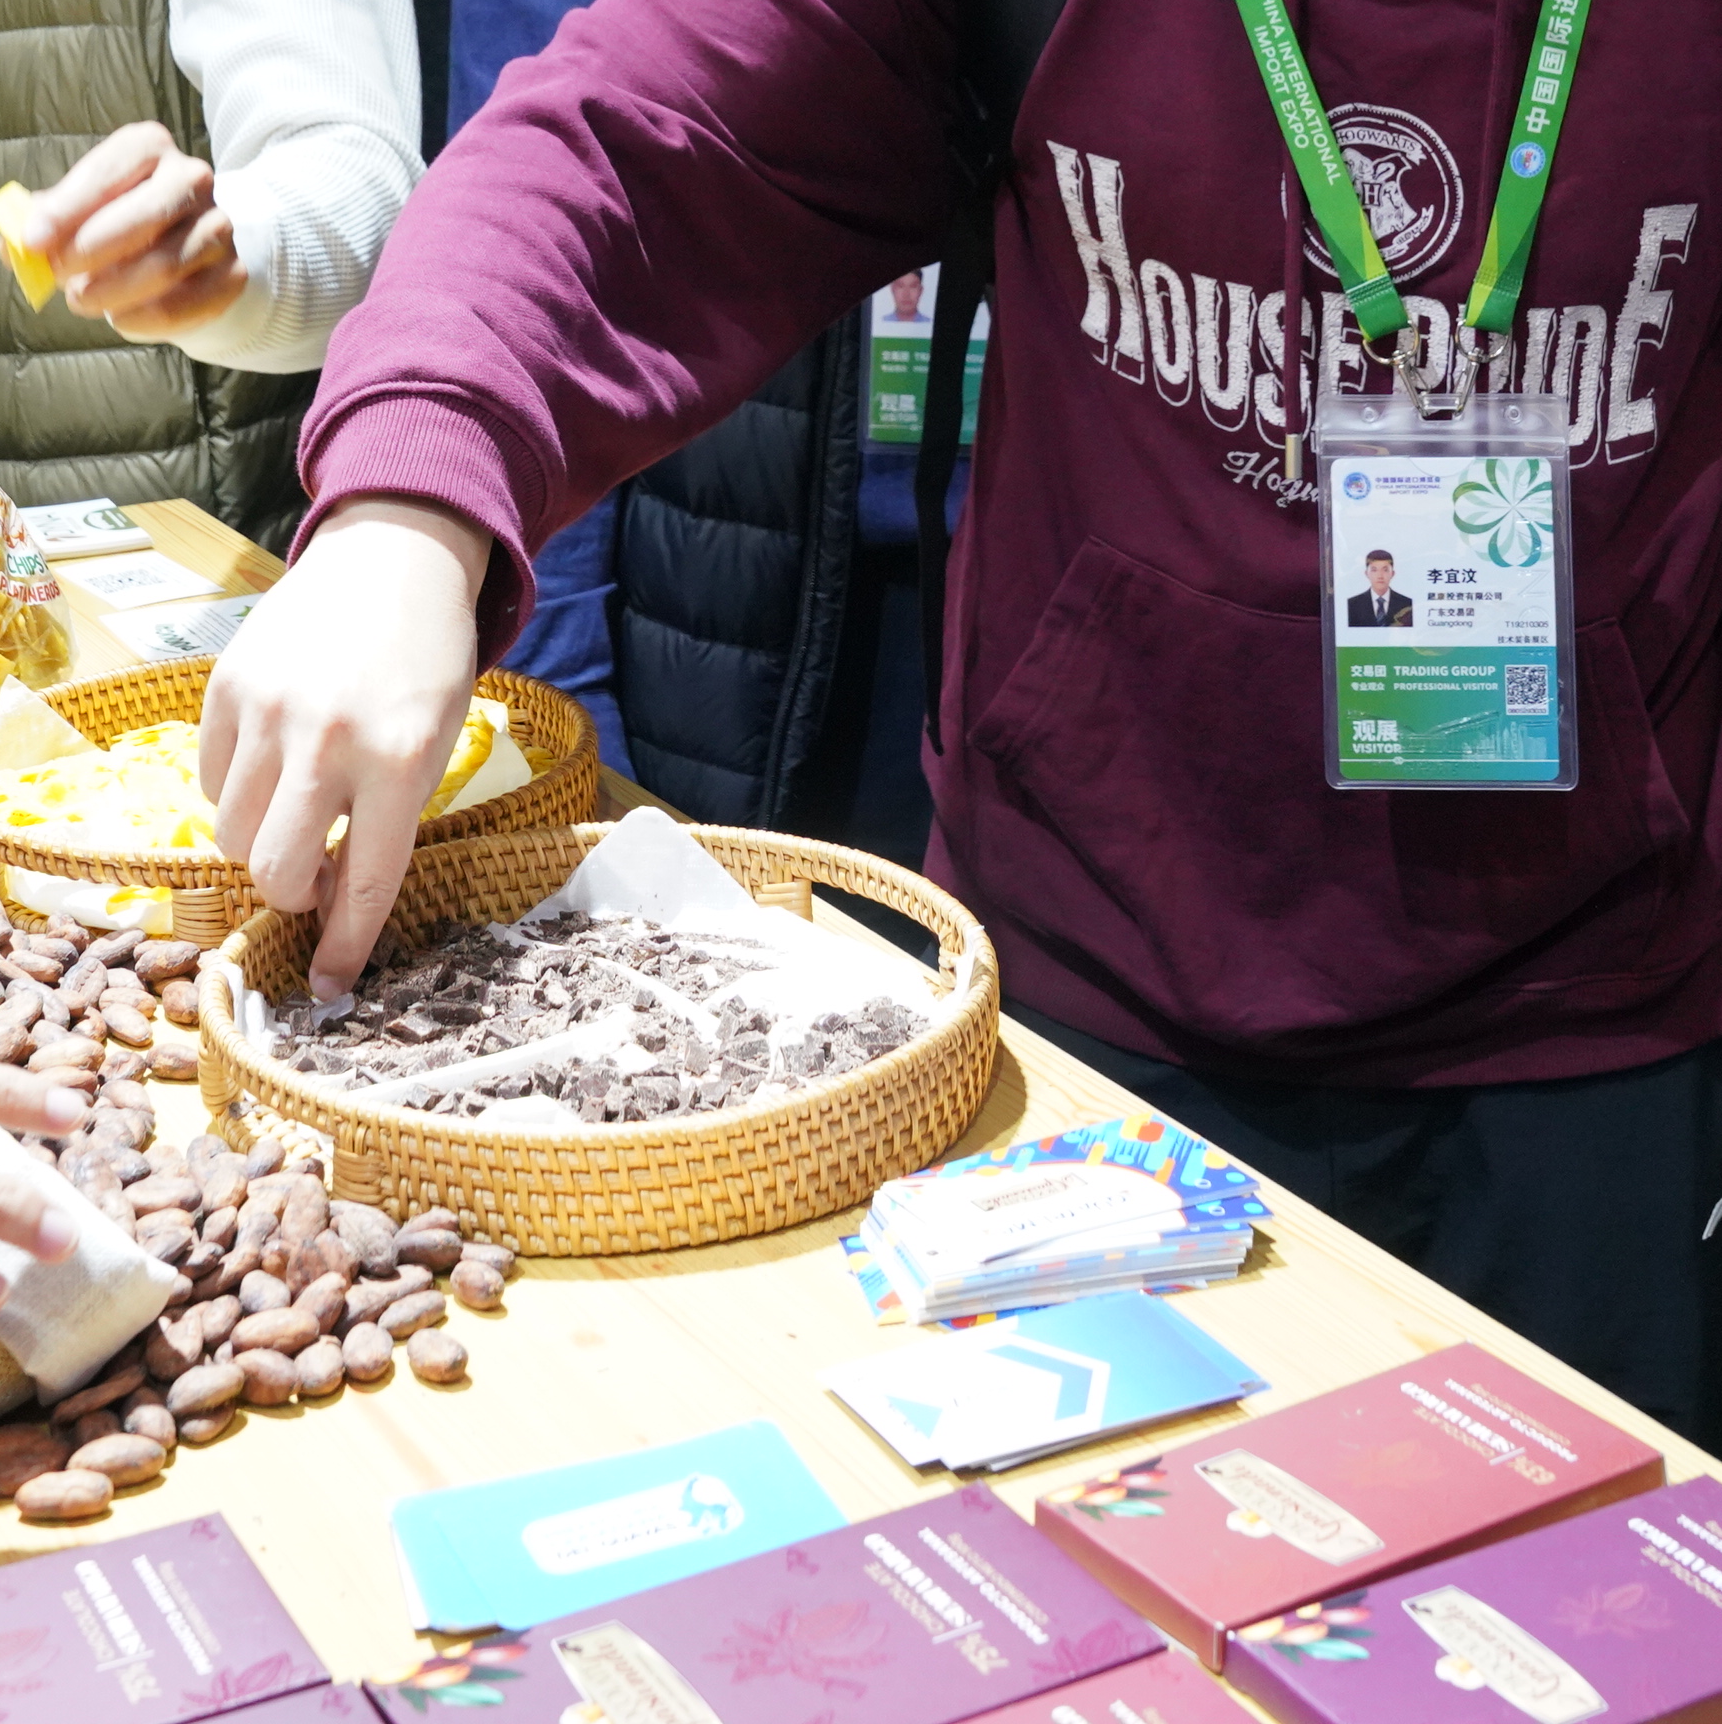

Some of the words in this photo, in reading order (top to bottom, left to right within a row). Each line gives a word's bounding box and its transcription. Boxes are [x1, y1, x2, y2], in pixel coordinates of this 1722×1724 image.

[1255, 25, 1291, 95] IMPORT
[1280, 99, 1309, 149] EXPO
[1278, 41, 1341, 186] INTERNATIONAL
[1336, 128, 1417, 153] HOGWARTS
[1046, 140, 1367, 444] HOUSE
[6, 552, 45, 575] CHIPS
[1427, 568, 1477, 584] 李宜汶
[1427, 607, 1475, 617] 广东交易团
[1428, 619, 1473, 628] Guangdong
[1350, 665, 1387, 677] 交易团
[1393, 665, 1449, 676] TRADING
[1451, 665, 1496, 676] GROUP
[1393, 682, 1461, 691] PROFESSIONAL
[1463, 682, 1499, 691] VISITOR
[1352, 720, 1398, 742] 观展
[1352, 743, 1402, 754] VISITOR
[1411, 1406, 1496, 1458] CHOCOLATE
[1510, 1418, 1579, 1463] PRODUCTO
[863, 1561, 946, 1636] CHOCOLATE
[979, 1582, 1050, 1646] PRODUCTO
[60, 1588, 116, 1662] CHOCOLATE
[955, 1632, 1010, 1676] 75%
